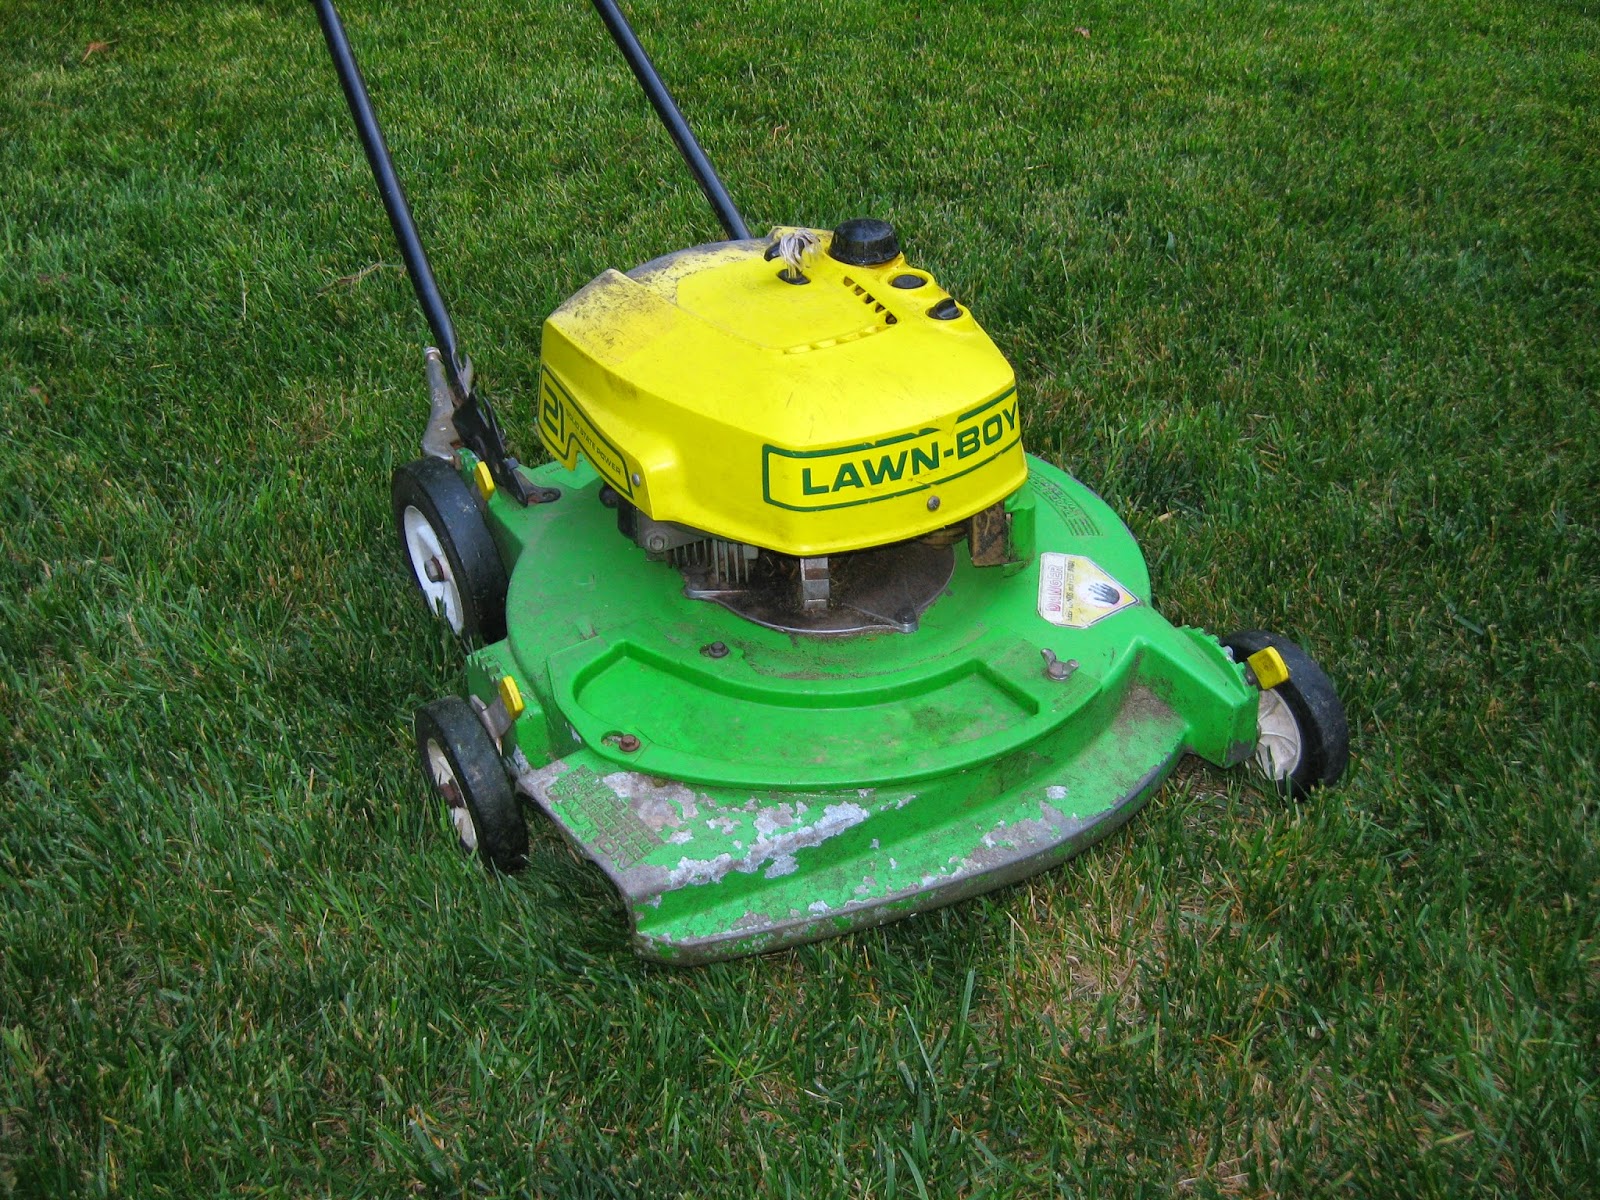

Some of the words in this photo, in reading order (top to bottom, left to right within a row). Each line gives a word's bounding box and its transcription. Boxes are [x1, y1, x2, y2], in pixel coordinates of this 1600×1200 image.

[597, 447, 621, 476] POWER
[802, 401, 1016, 496] LAWN-BOY
[1045, 564, 1063, 612] DANGER
